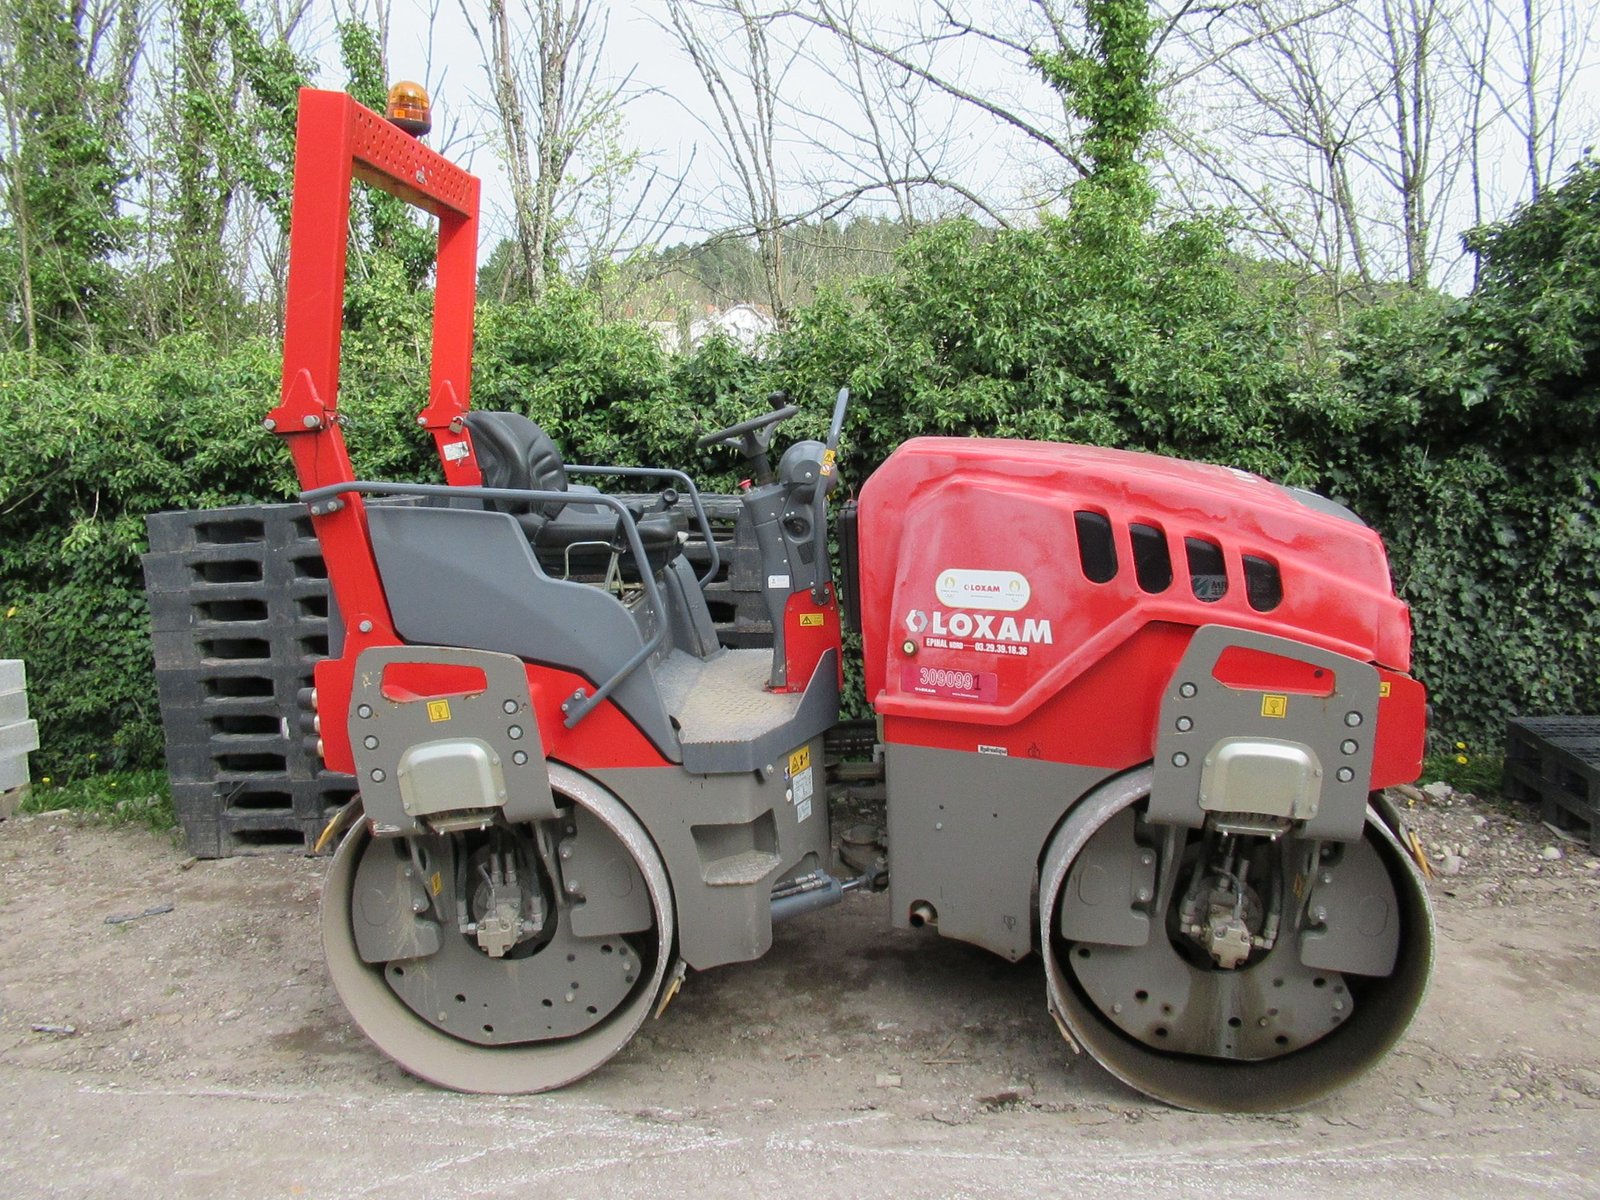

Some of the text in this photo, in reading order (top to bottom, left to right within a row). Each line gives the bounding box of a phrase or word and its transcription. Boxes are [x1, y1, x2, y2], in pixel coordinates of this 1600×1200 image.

[970, 584, 1001, 593] LOXAM
[932, 611, 1053, 644] LOXAM
[926, 637, 948, 649] EPINAL
